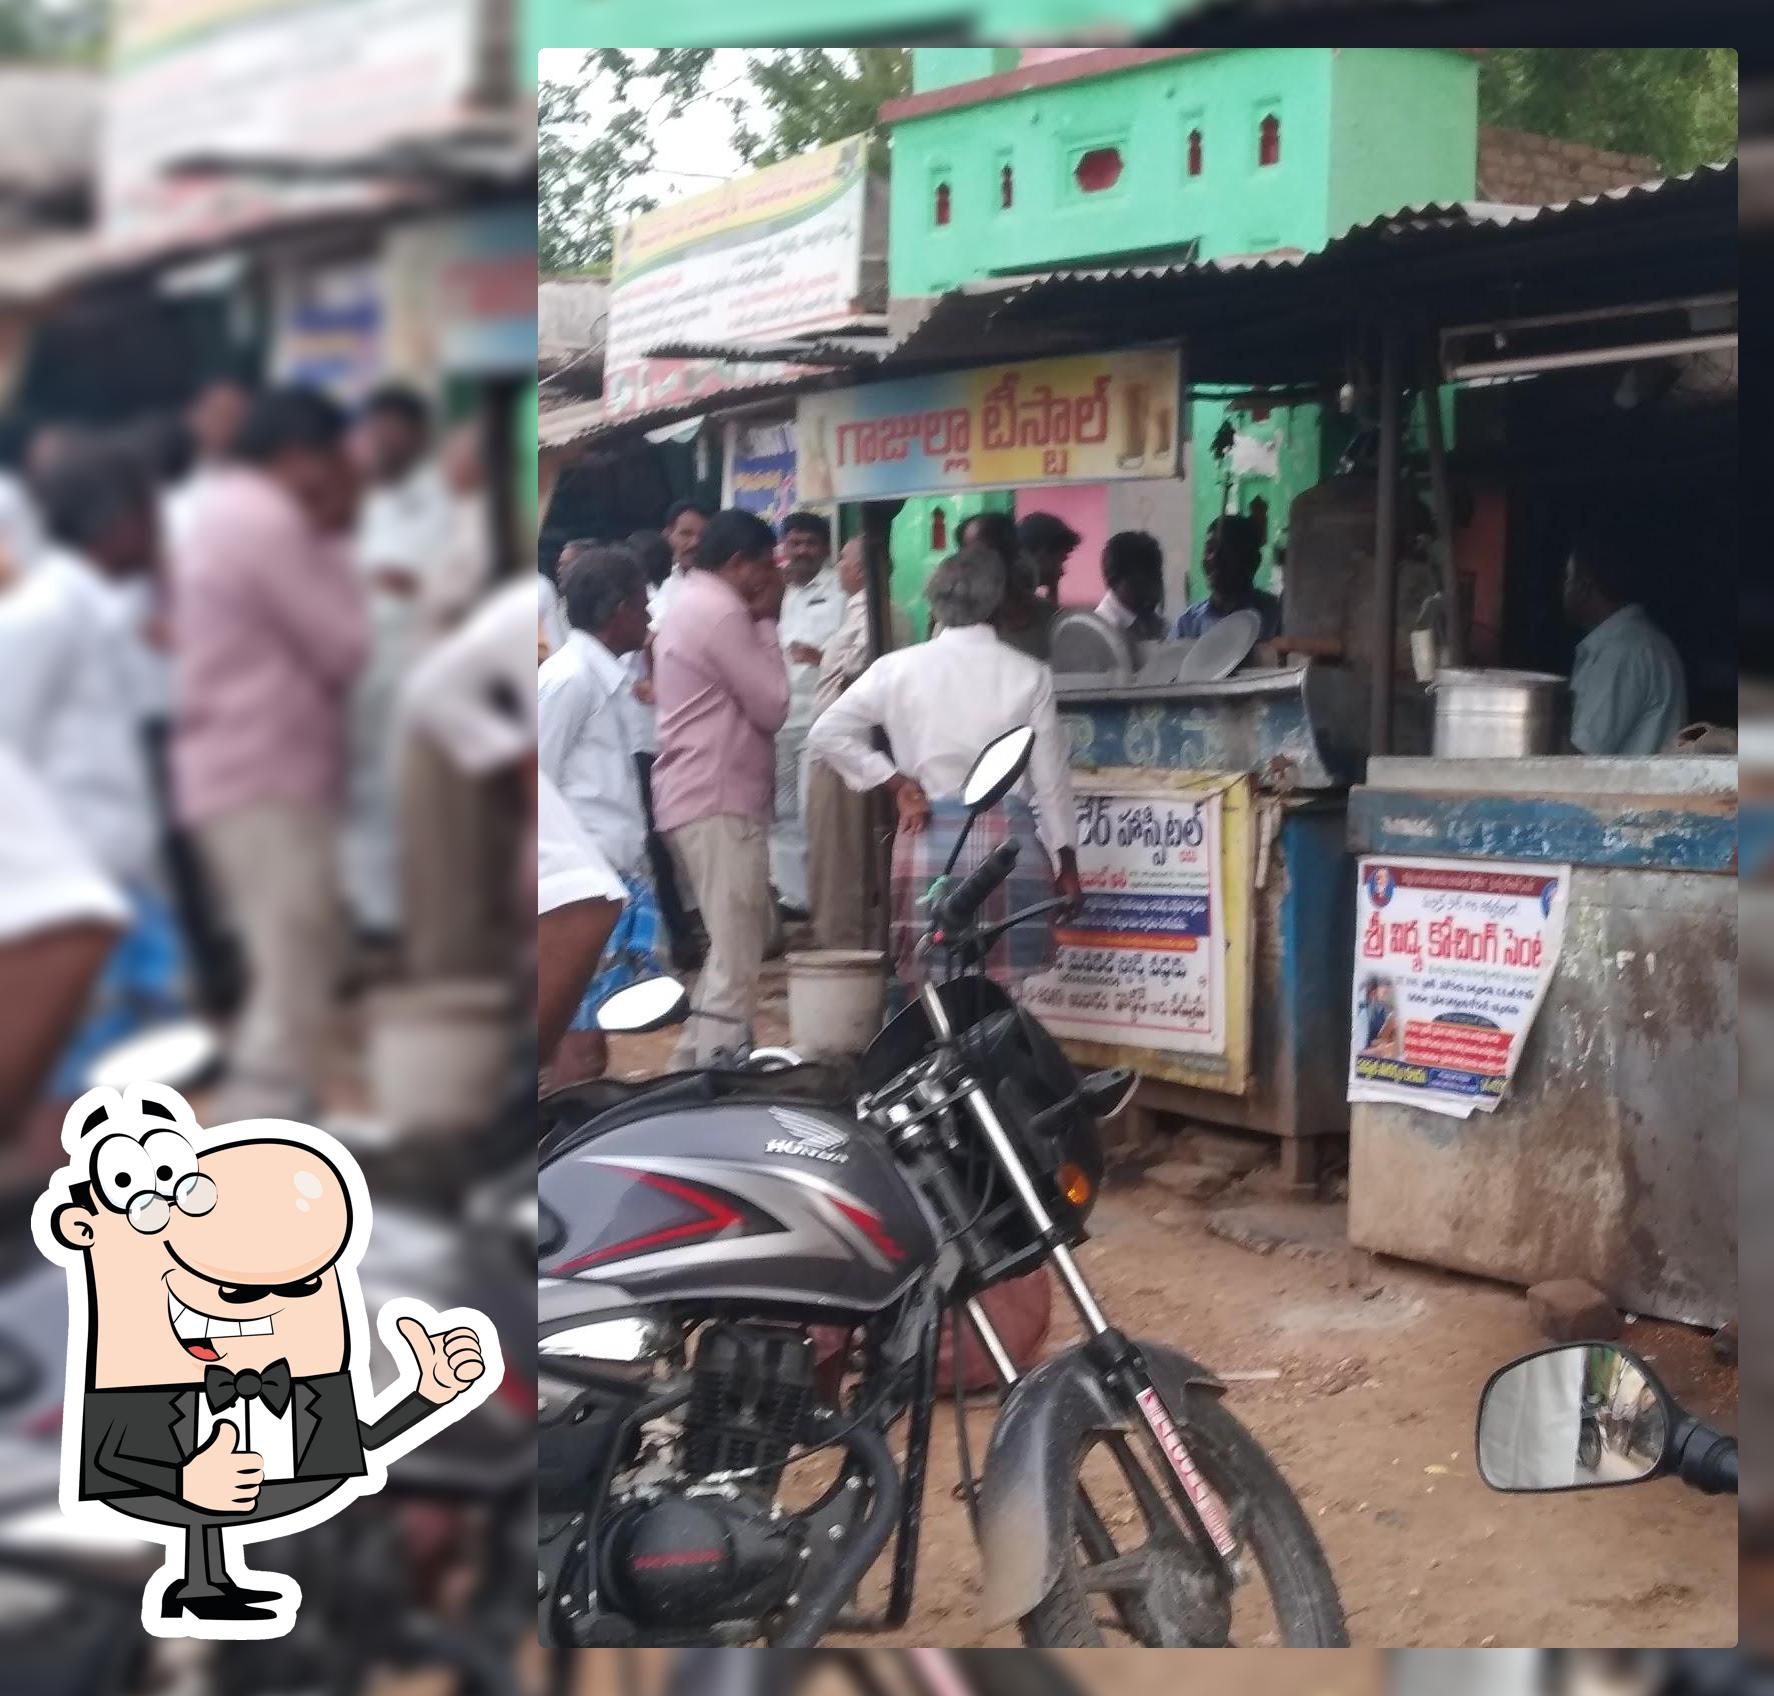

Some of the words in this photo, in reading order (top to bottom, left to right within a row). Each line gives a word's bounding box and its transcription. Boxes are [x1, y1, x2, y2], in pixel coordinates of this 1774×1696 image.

[982, 373, 1110, 475] టీస్టాల్
[1117, 801, 1204, 865] హాస్పిటల్
[1363, 910, 1385, 958] శ్రీ
[1428, 915, 1498, 964] కోచింగ్
[764, 1139, 848, 1163] HONDA
